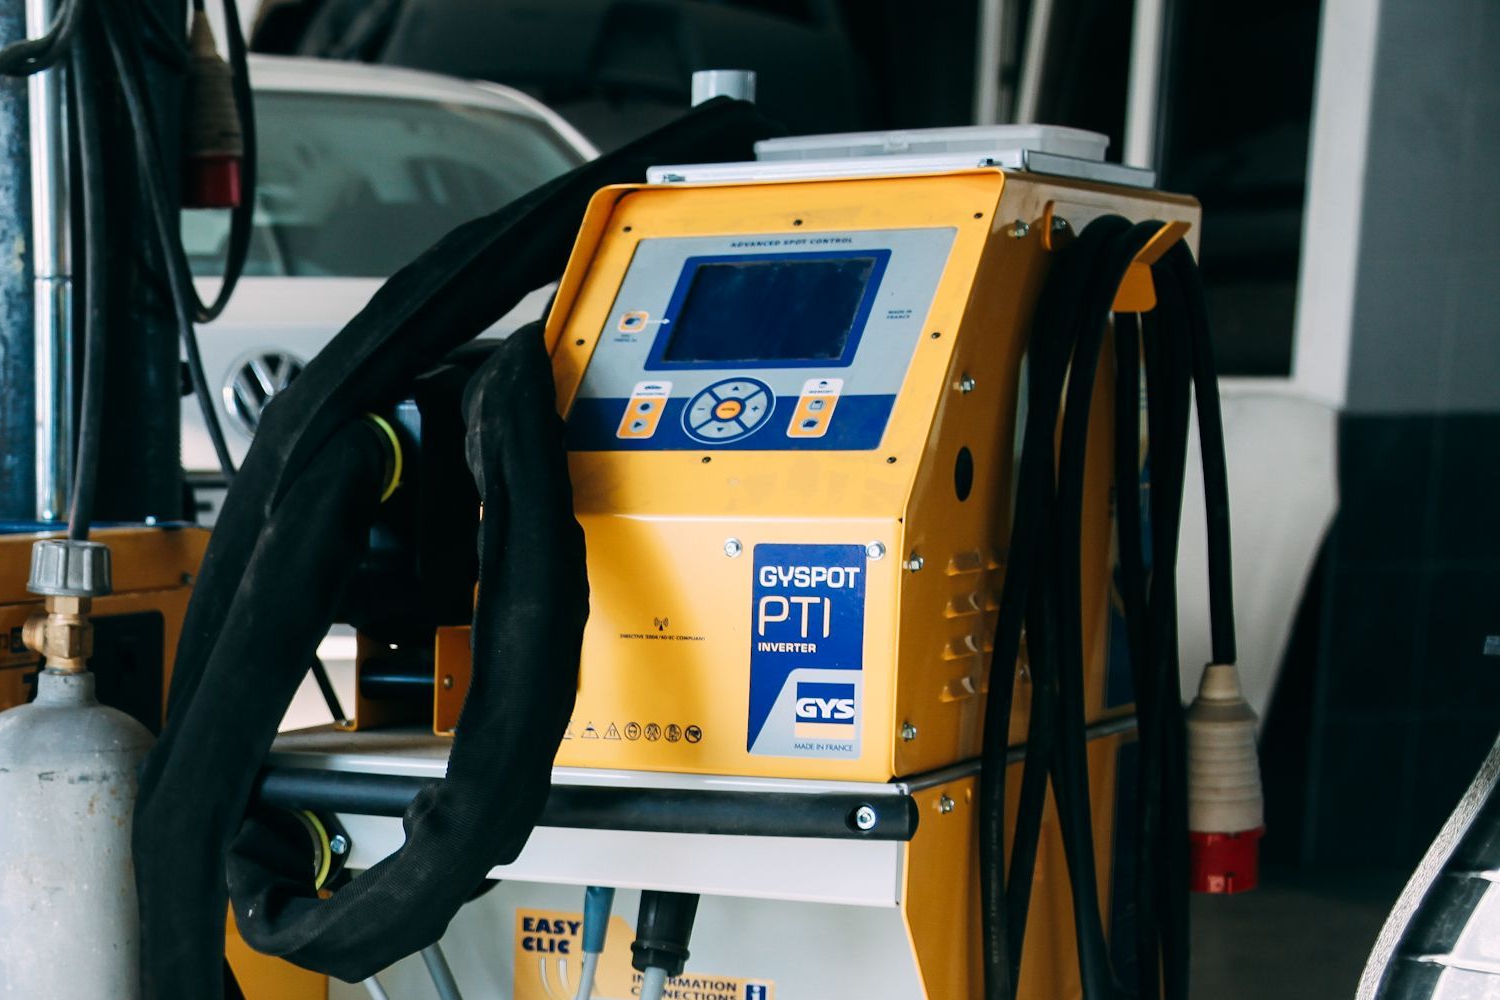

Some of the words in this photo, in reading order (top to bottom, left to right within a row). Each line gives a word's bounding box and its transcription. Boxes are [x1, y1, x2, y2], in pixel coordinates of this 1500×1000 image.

[731, 240, 781, 248] ADVANCED
[783, 238, 807, 246] SPOT
[809, 237, 853, 245] CONTROL
[759, 566, 860, 588] GYSPOT
[758, 595, 831, 639] PTI
[757, 642, 817, 653] INVERTER
[796, 697, 855, 720] GYS
[825, 744, 853, 752] FRANCE
[522, 917, 582, 936] EASY
[522, 937, 571, 954] CLIC
